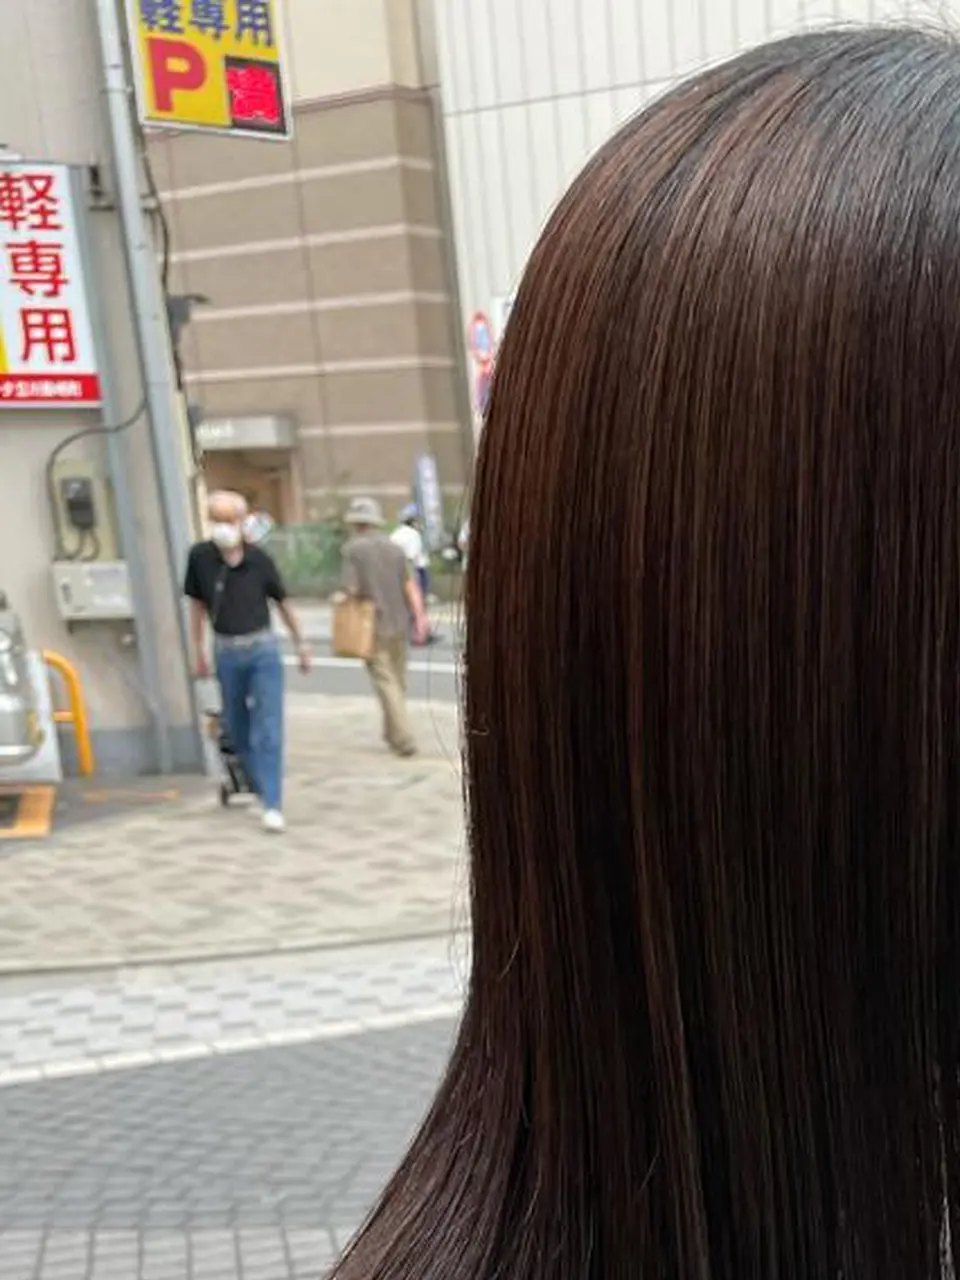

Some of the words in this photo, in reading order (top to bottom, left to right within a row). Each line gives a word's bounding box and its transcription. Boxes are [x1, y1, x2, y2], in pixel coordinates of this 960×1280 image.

[146, 38, 207, 112] P
[0, 173, 76, 363] 軽専用
